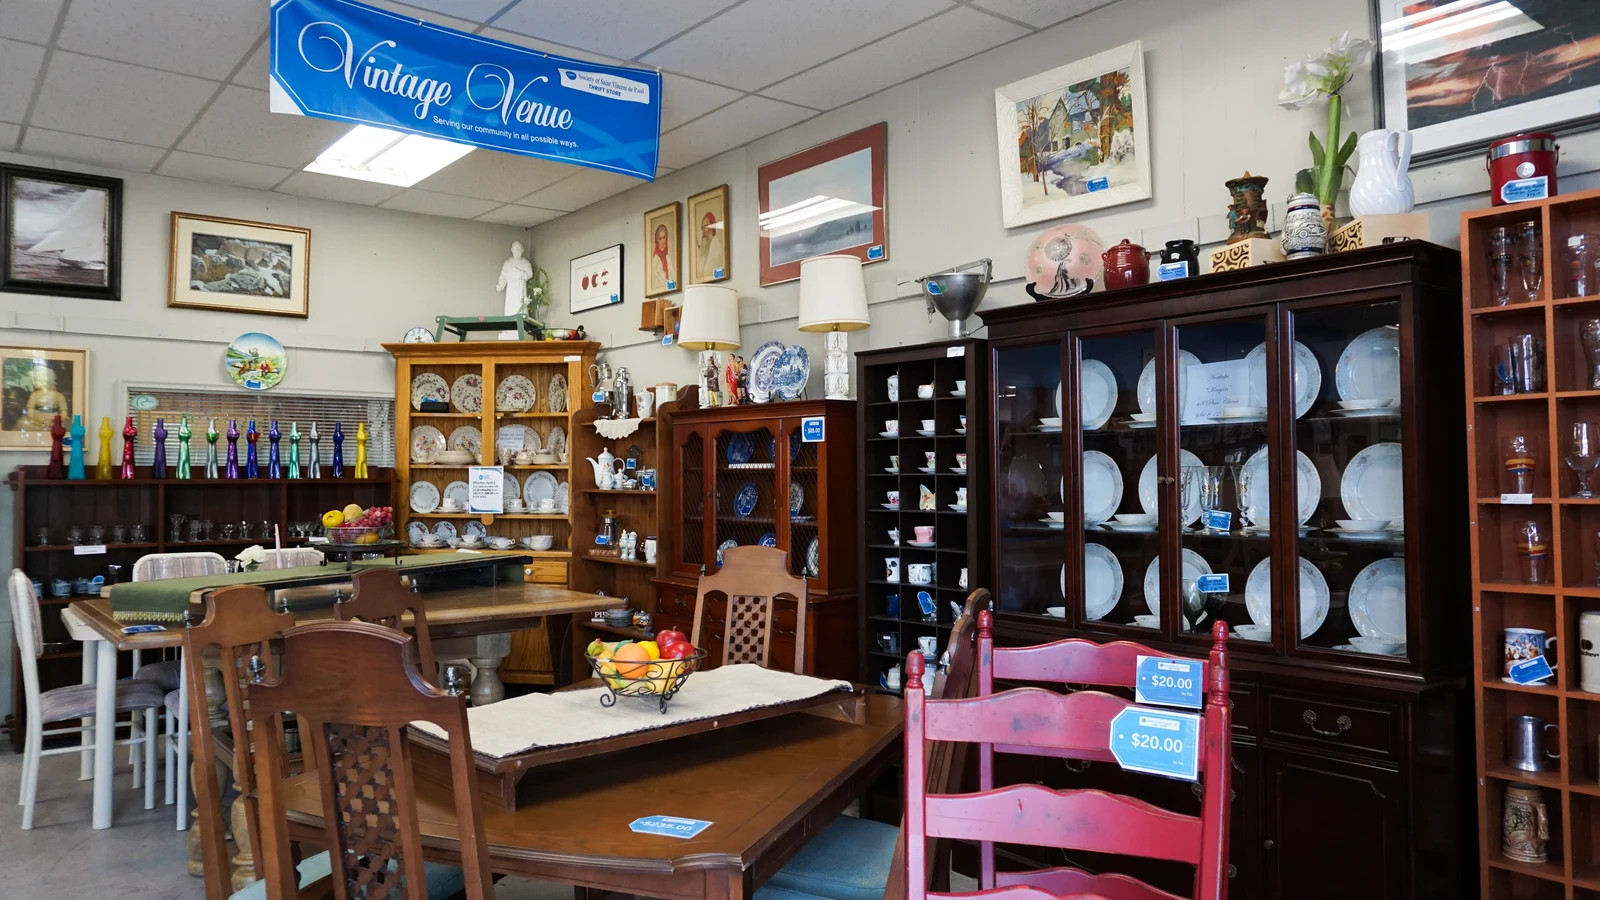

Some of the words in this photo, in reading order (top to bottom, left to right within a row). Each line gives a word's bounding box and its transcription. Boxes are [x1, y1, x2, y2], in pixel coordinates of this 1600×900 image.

[298, 21, 452, 120] Vintage
[466, 63, 573, 129] Venue
[578, 73, 595, 82] Society
[600, 79, 612, 87] Saint
[612, 81, 628, 92] Vincent
[588, 84, 605, 92] THRIFT
[433, 115, 460, 130] Serving
[461, 123, 474, 131] our
[475, 125, 513, 139] community
[513, 131, 520, 139] in
[521, 133, 529, 141] all
[530, 135, 558, 145] possible
[560, 139, 579, 148] ways.
[1151, 674, 1192, 690] $20.00
[1131, 732, 1183, 753] $20.00
[642, 820, 693, 831] $235.00
